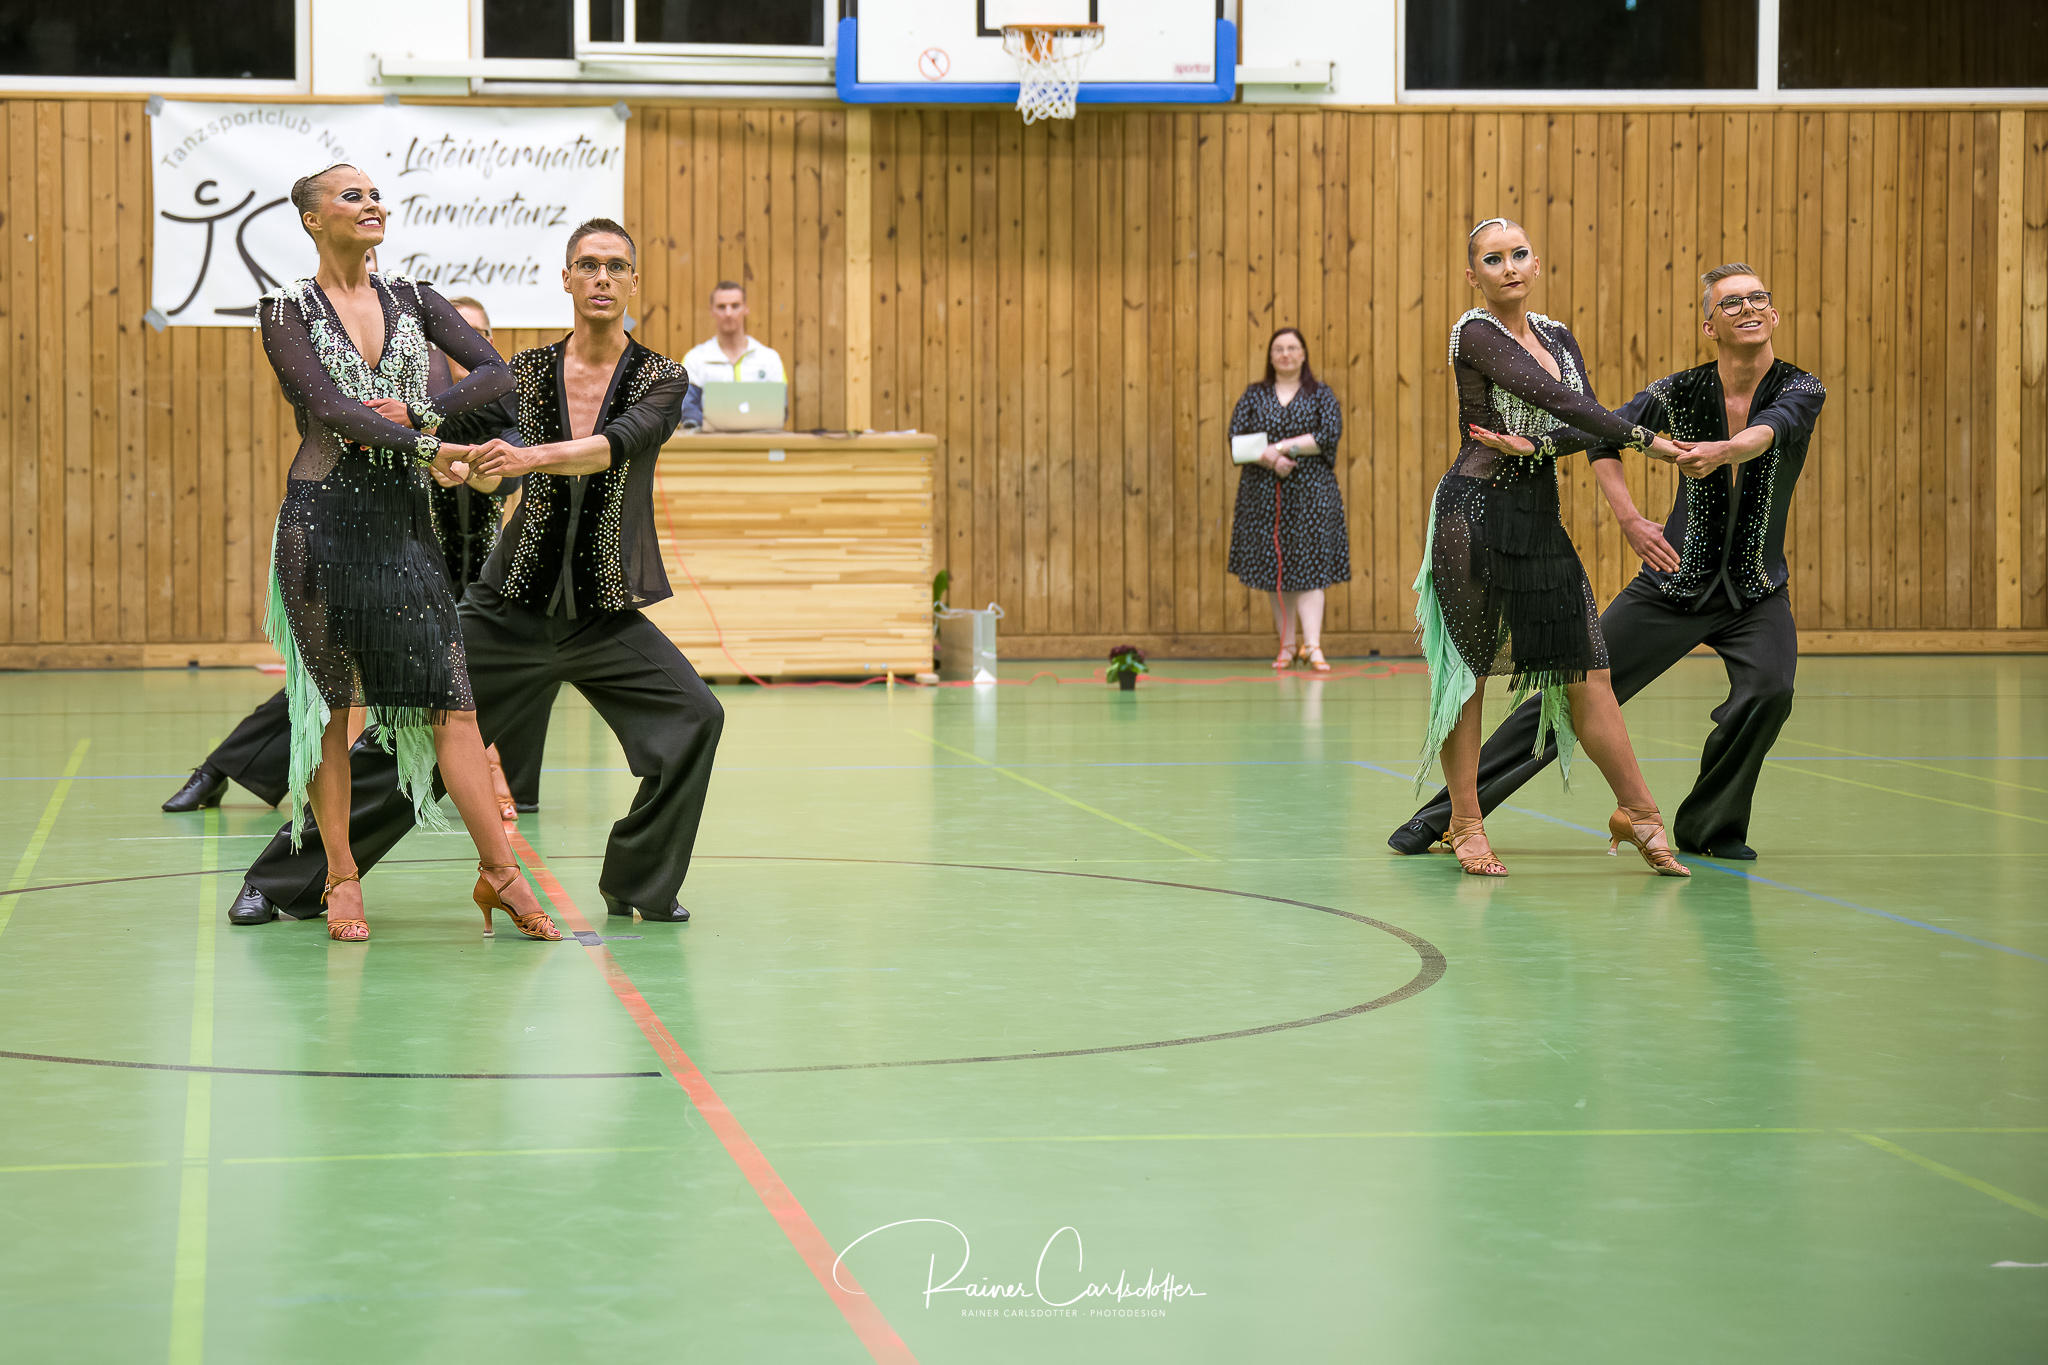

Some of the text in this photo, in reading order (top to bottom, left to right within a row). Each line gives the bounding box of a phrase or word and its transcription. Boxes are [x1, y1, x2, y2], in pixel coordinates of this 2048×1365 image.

[161, 108, 312, 169] Tanzsportclub
[399, 134, 620, 178] Lateinformation
[400, 192, 568, 229] Turniertanz
[401, 253, 540, 286] Tanzkreis
